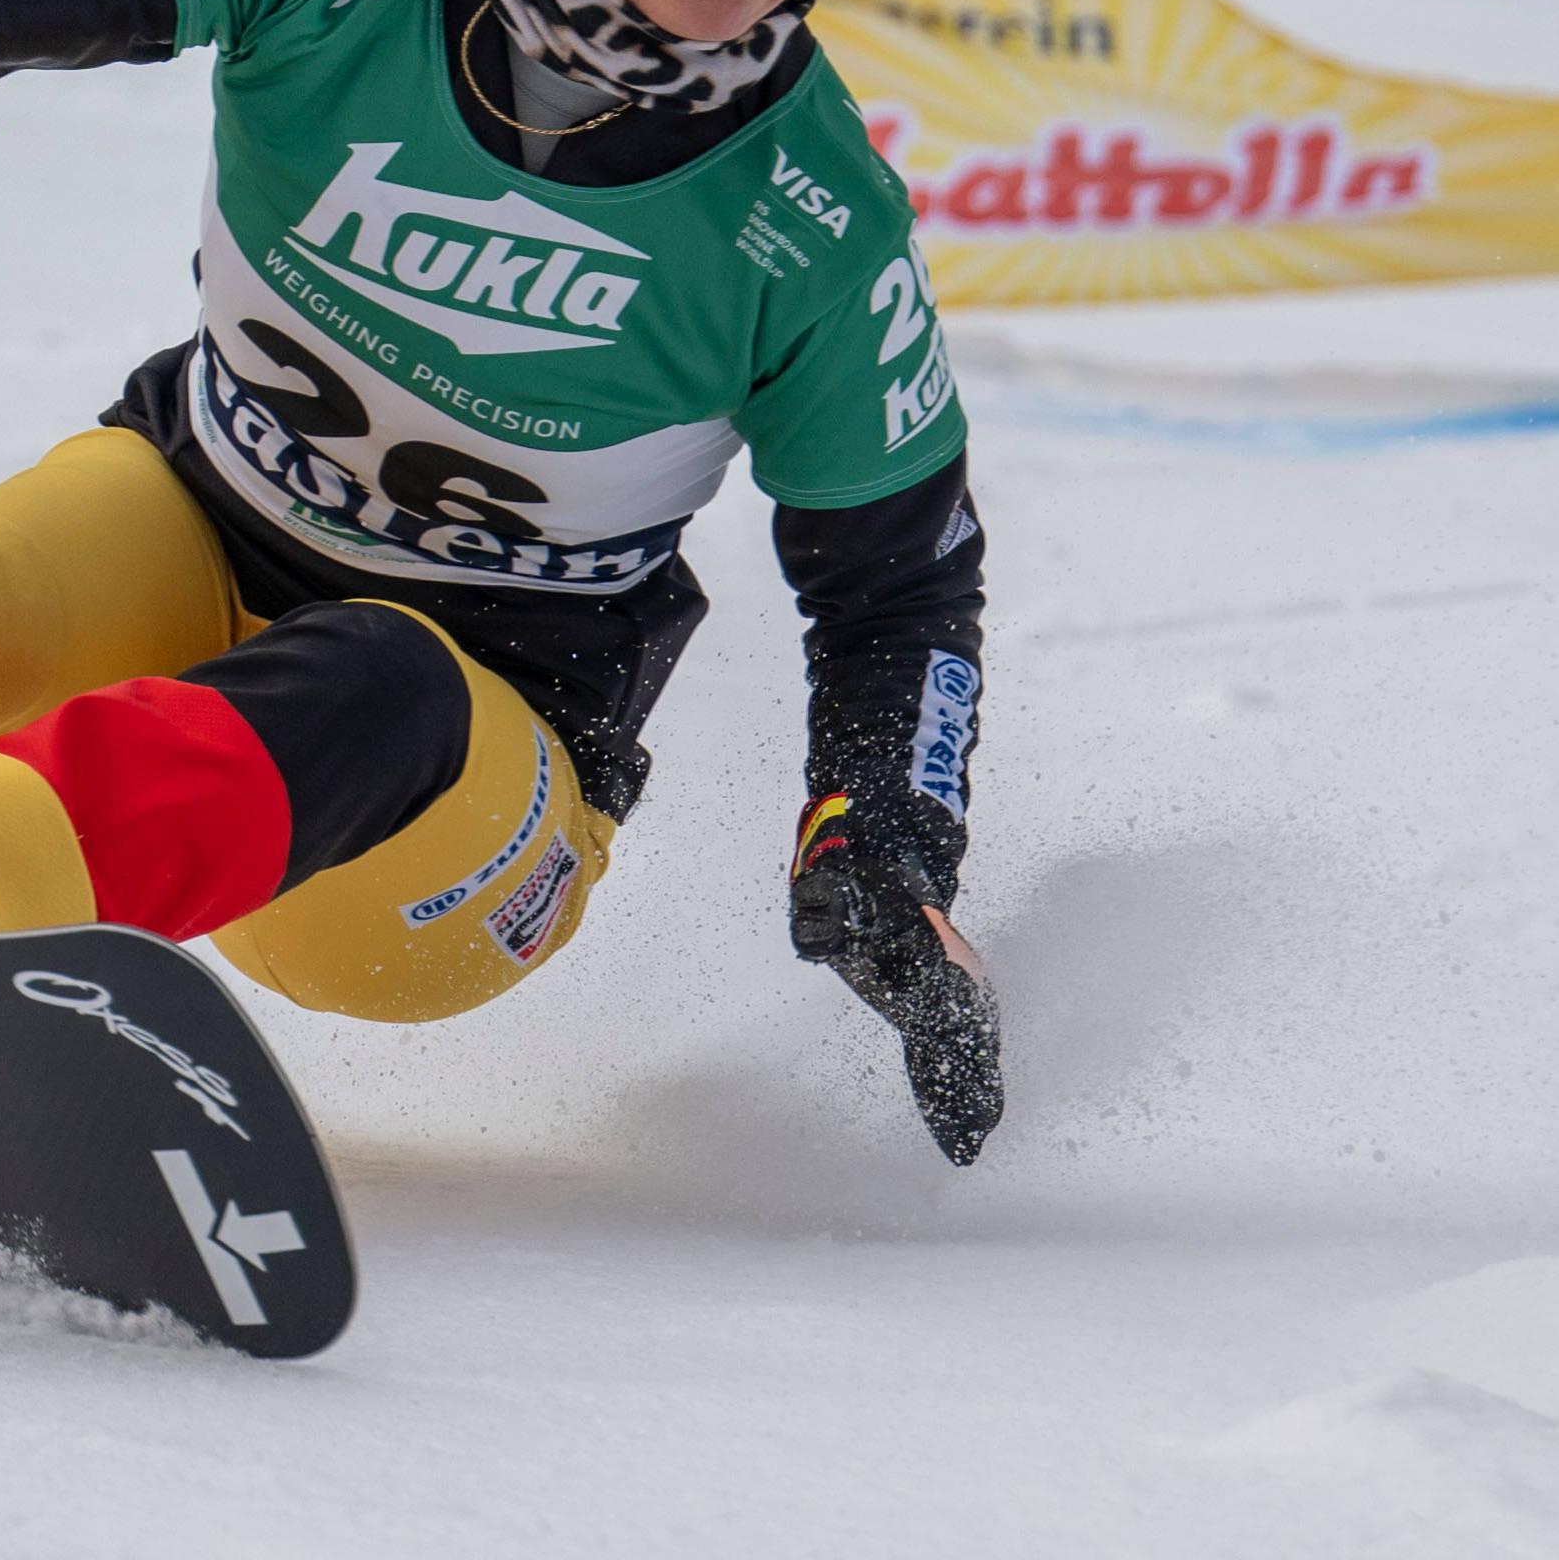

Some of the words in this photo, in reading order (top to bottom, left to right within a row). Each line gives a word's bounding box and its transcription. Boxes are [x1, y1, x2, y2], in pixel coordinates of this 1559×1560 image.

[283, 141, 653, 332] Kukla
[770, 144, 852, 239] VISA
[264, 248, 402, 366] WEIGHING
[411, 362, 583, 442] PRECISION
